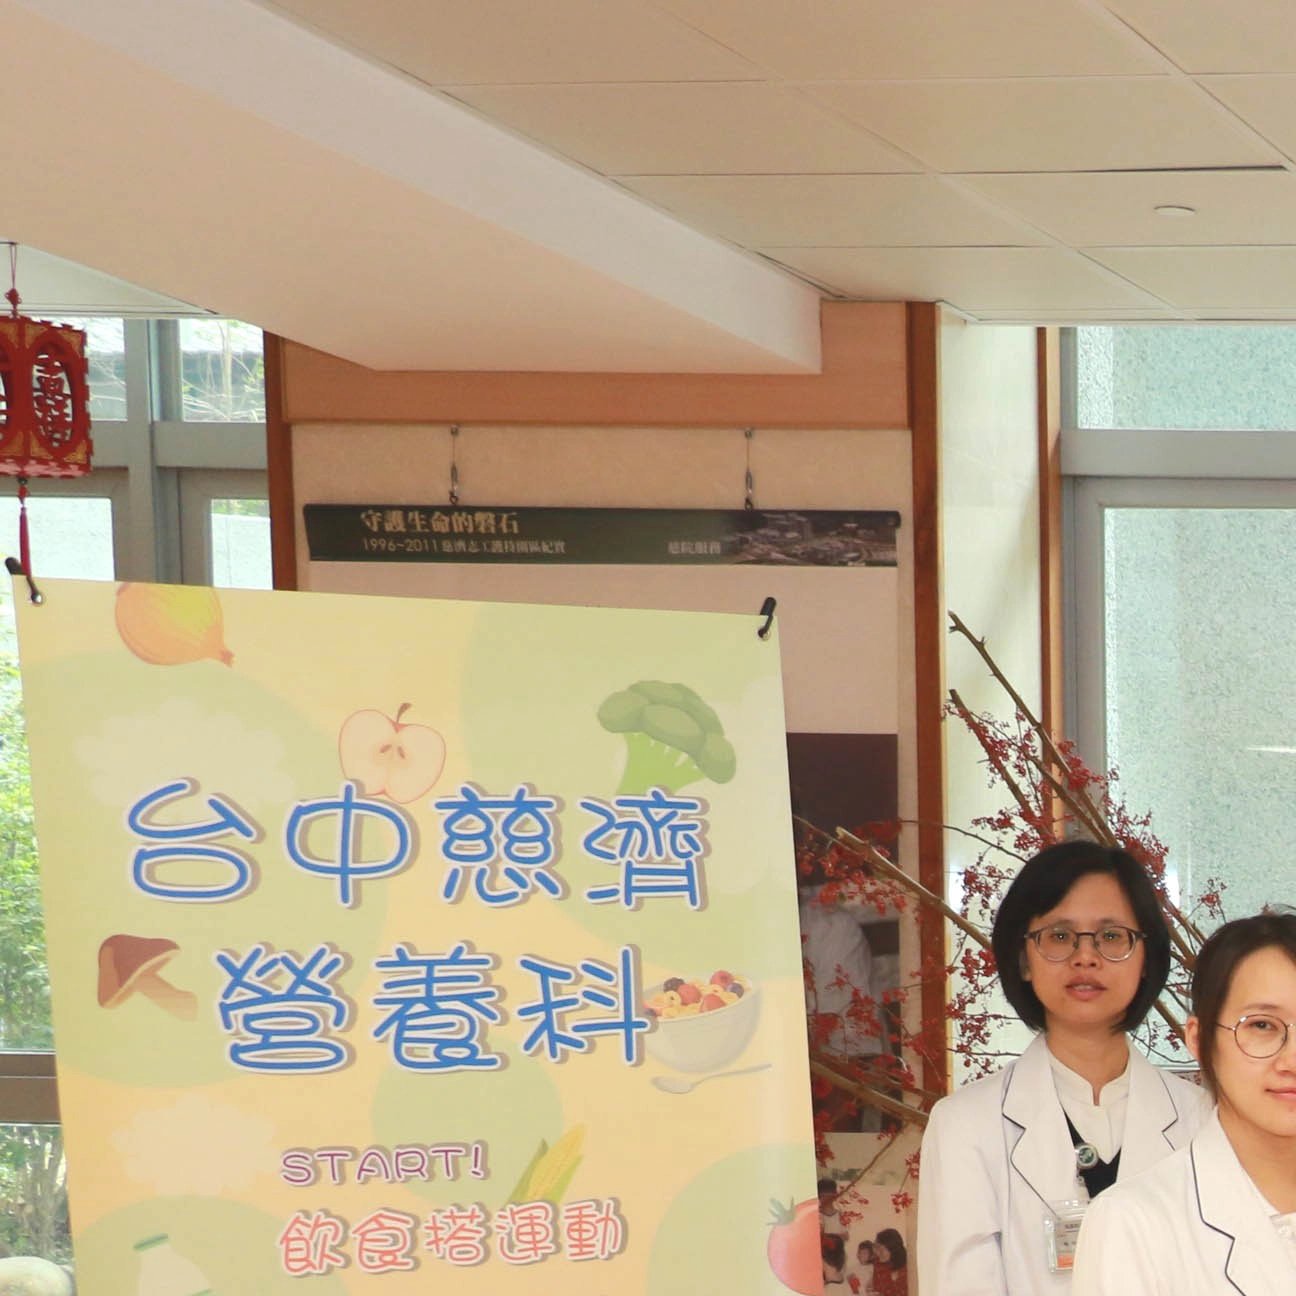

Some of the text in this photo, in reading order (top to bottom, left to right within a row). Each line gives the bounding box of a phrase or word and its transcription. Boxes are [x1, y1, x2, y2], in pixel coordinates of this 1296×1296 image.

[360, 509, 520, 535] 守護生命的磐石
[125, 779, 706, 909] 台中慈濟
[215, 942, 653, 1074] 營養科
[281, 1143, 484, 1185] START!
[279, 1200, 624, 1275] 飲食搭運動
